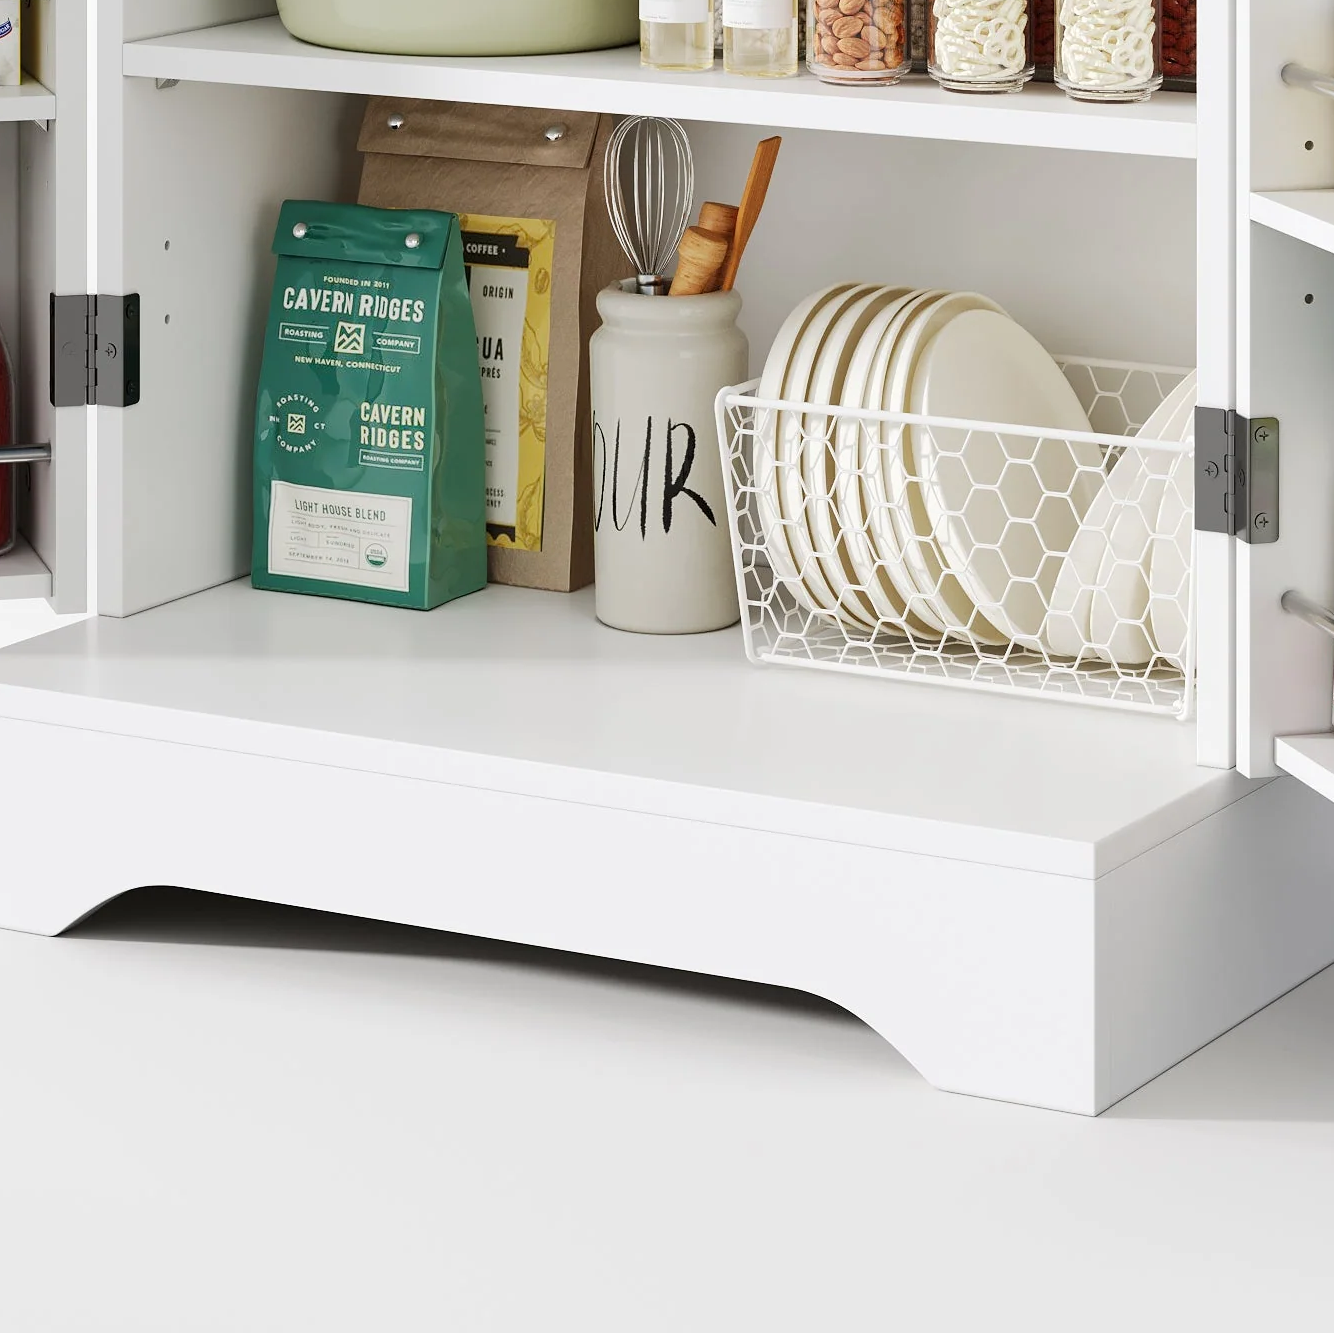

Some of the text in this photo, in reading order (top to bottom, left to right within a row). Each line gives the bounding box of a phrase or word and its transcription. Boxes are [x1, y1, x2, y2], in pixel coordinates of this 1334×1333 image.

[466, 243, 498, 256] COFFEE
[323, 276, 359, 286] FOUNDED
[374, 281, 389, 289] 2011
[482, 284, 514, 299] ORIGIN
[283, 287, 425, 322] CAVERN RIDGES
[284, 328, 415, 348] ROASTING COMPANY
[315, 357, 344, 368] HAVEN,
[346, 361, 401, 373] CONNECTICUT
[276, 394, 319, 413] ROASTING
[360, 402, 425, 426] CAVERN
[314, 422, 326, 430] CT
[276, 435, 317, 453] COMPANY
[360, 426, 425, 450] RIDGES
[362, 455, 420, 466] ROASTING COMPANY
[295, 499, 386, 521] LIGHT HOUSE BLEND
